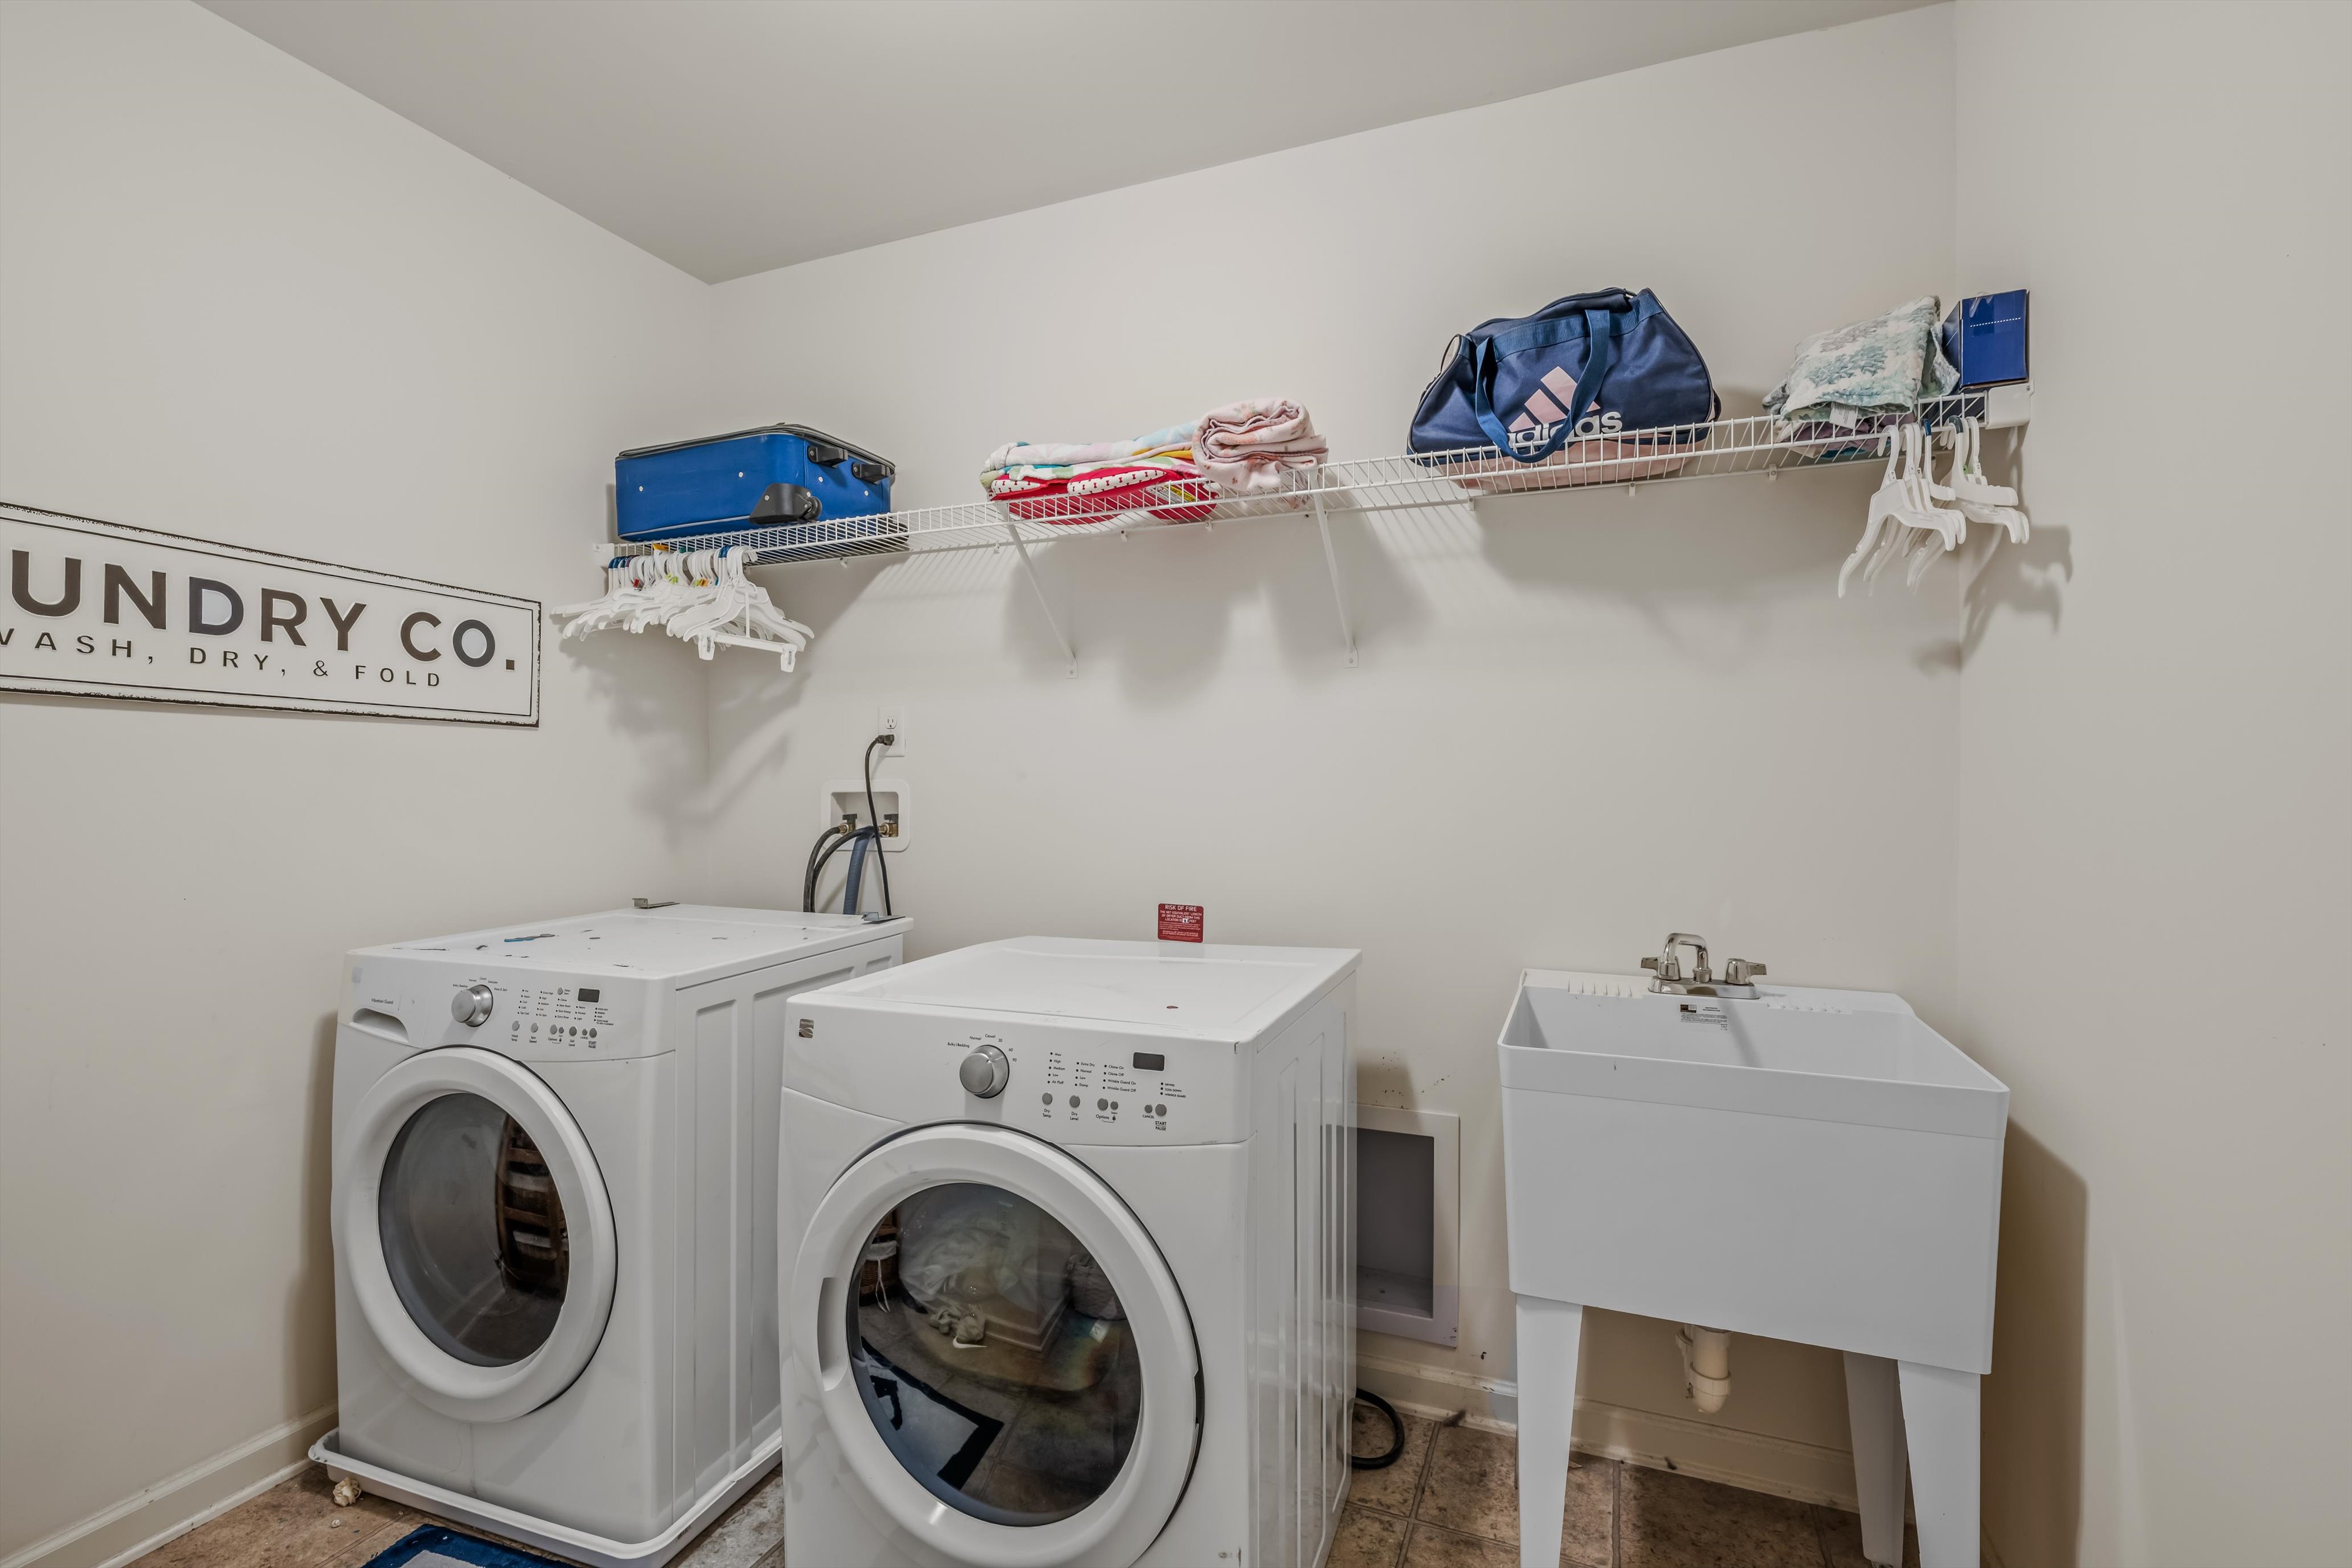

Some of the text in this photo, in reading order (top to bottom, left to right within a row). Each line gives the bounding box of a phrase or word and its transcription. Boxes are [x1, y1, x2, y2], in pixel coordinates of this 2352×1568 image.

[1507, 412, 1623, 447] dias
[12, 549, 515, 671] UNDRY CO.
[189, 647, 286, 676] DRY,
[313, 660, 328, 677] &
[355, 665, 440, 687] FOLD
